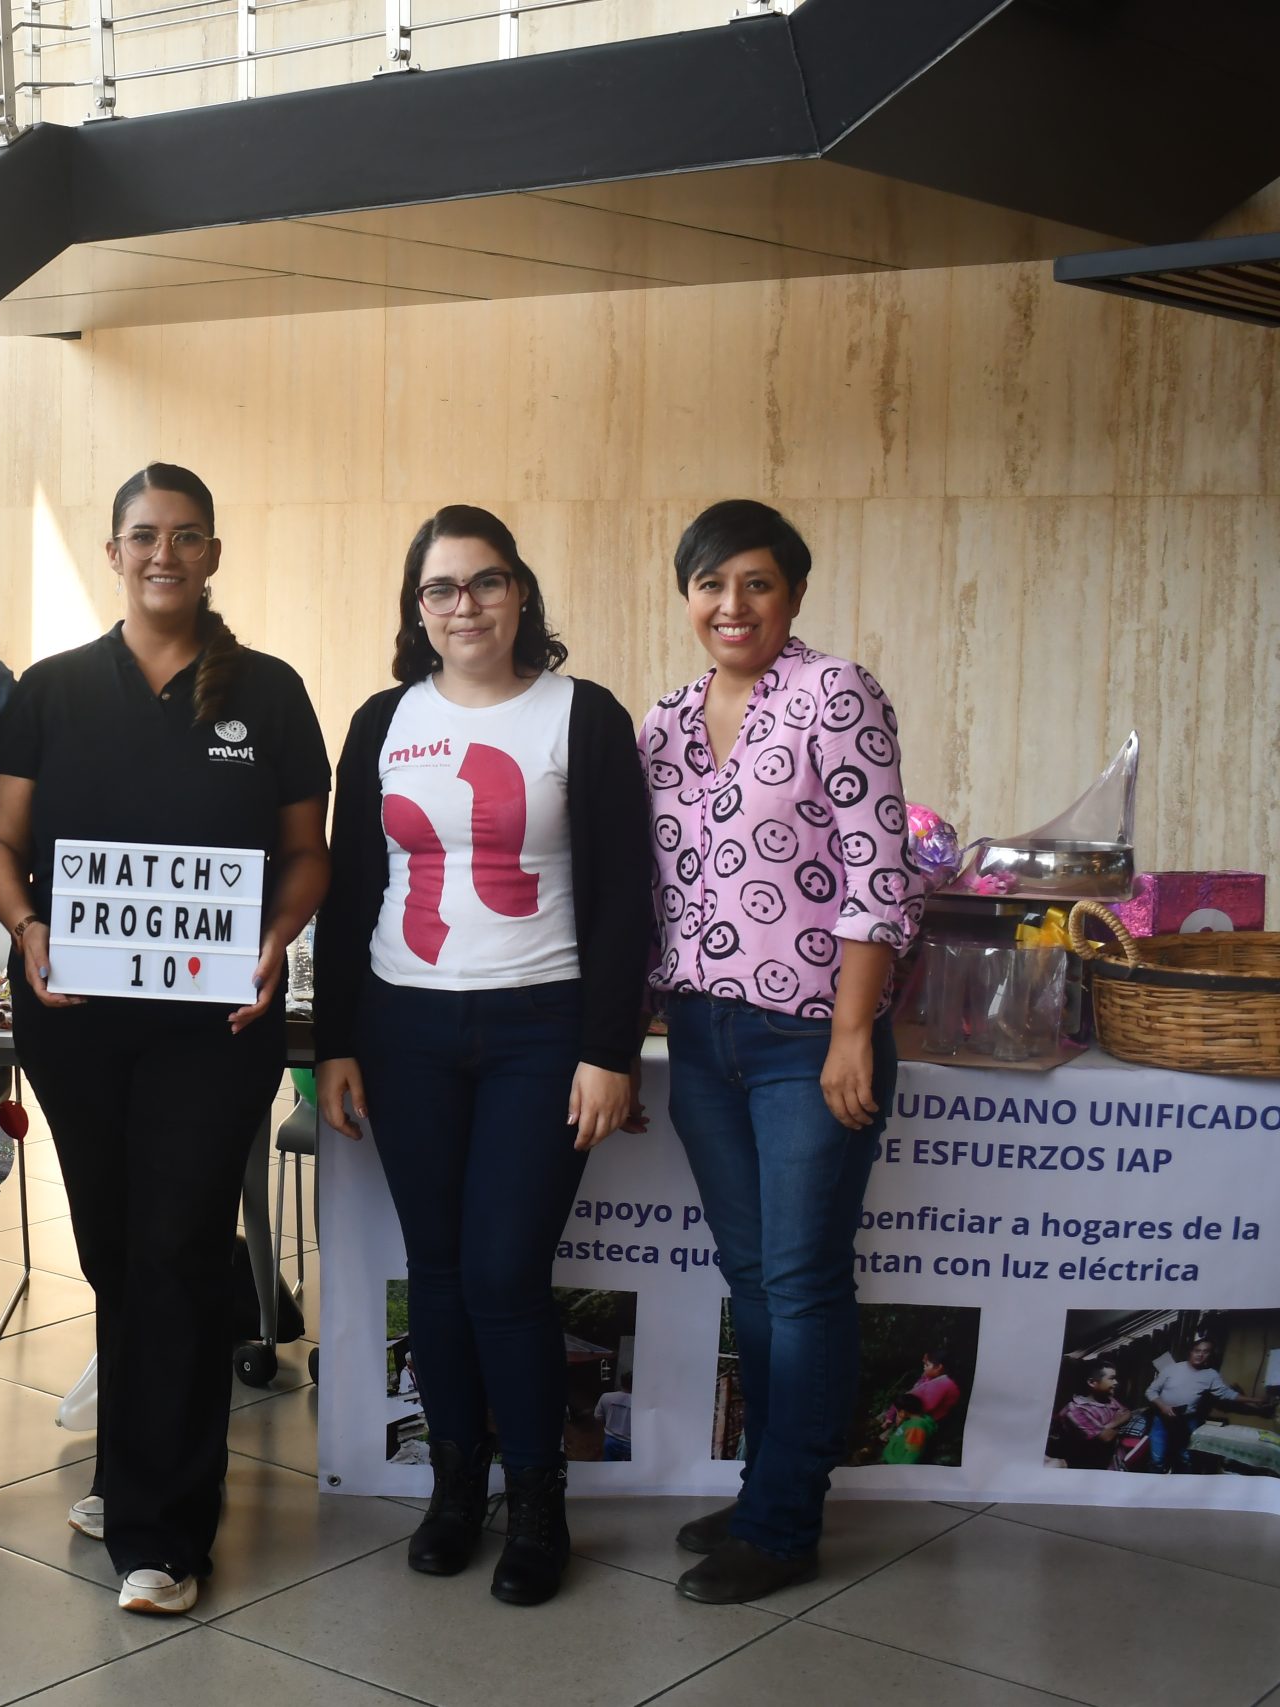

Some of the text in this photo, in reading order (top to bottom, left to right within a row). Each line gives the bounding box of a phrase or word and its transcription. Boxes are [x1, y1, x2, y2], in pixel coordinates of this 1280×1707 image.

[208, 745, 255, 761] muvi
[388, 738, 451, 764] muvi
[88, 852, 211, 890] MATCH
[70, 901, 233, 942] PROGRAM
[1089, 1101, 1280, 1131] UNIFICADO
[913, 1139, 1105, 1172] ESFUERZOS
[1116, 1147, 1173, 1173] IAP
[575, 1199, 672, 1228] apoyo
[857, 1206, 1002, 1235] benficiar
[1011, 1214, 1030, 1236] a
[1041, 1212, 1172, 1245] hogares
[1182, 1215, 1222, 1241] de
[1232, 1216, 1260, 1241] la
[933, 1255, 991, 1277] con
[1002, 1253, 1048, 1279] luz
[1058, 1254, 1200, 1281] eléctrica
